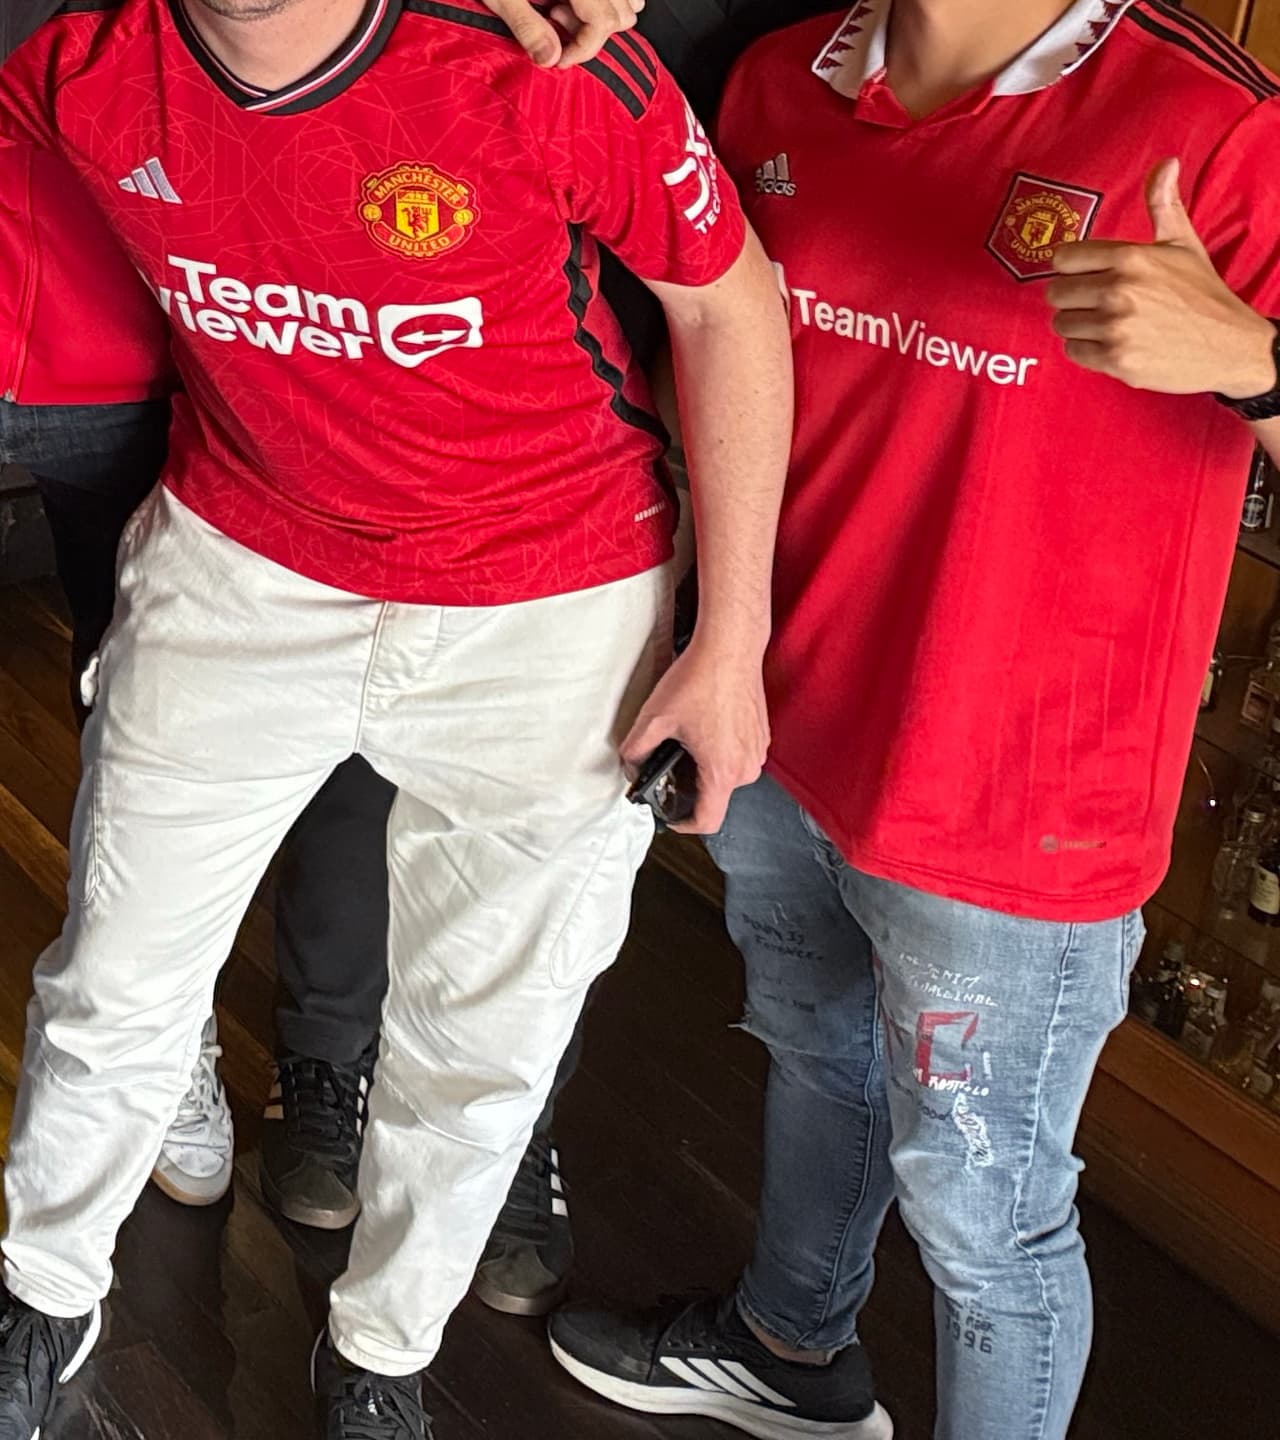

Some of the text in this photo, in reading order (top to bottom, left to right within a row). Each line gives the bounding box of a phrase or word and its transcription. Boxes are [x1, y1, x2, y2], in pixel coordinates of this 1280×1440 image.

[374, 172, 461, 205] MANCHESTER
[389, 235, 450, 252] UNITED
[167, 254, 370, 333] Team
[790, 287, 1038, 386] TeamViewer
